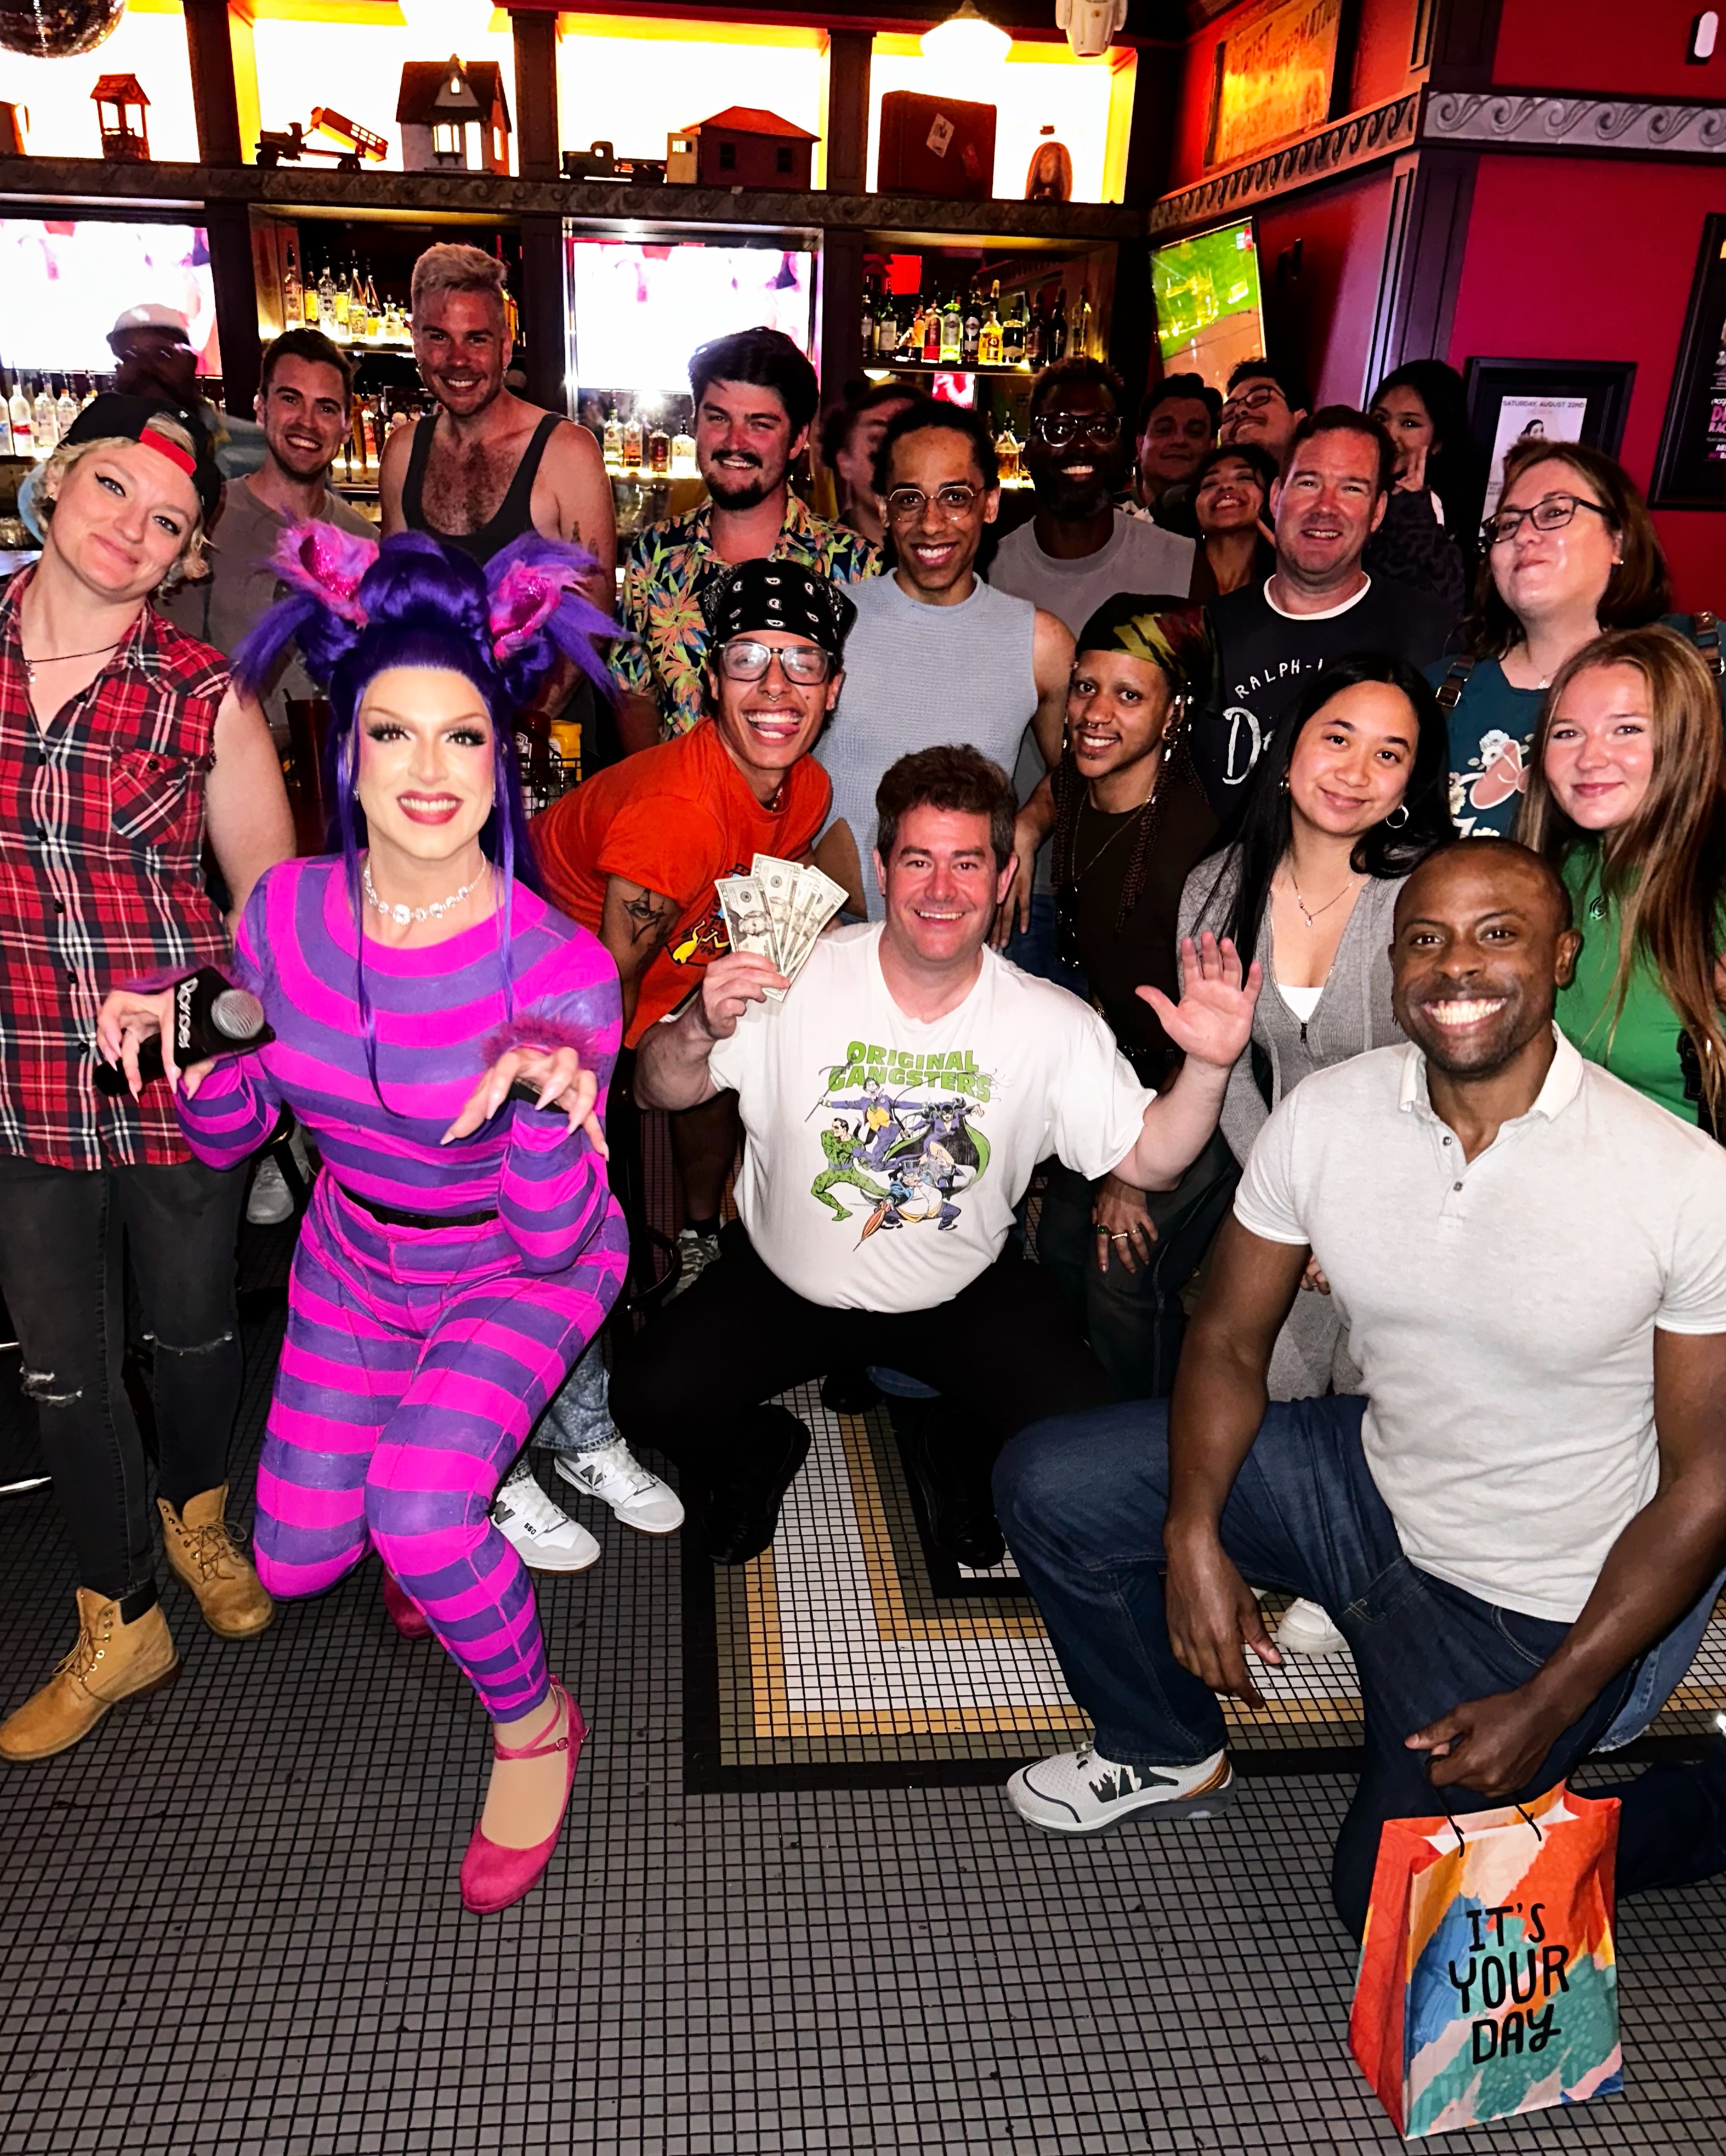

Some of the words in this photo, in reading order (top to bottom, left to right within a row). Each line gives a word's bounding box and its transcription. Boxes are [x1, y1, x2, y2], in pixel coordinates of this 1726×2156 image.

[847, 1041, 979, 1072] ORIGINAL
[828, 1065, 992, 1103] GANGSTERS
[1466, 1902, 1546, 1952] IT'S
[1448, 1944, 1570, 2014] YOUR
[1472, 2003, 1562, 2065] DAY
